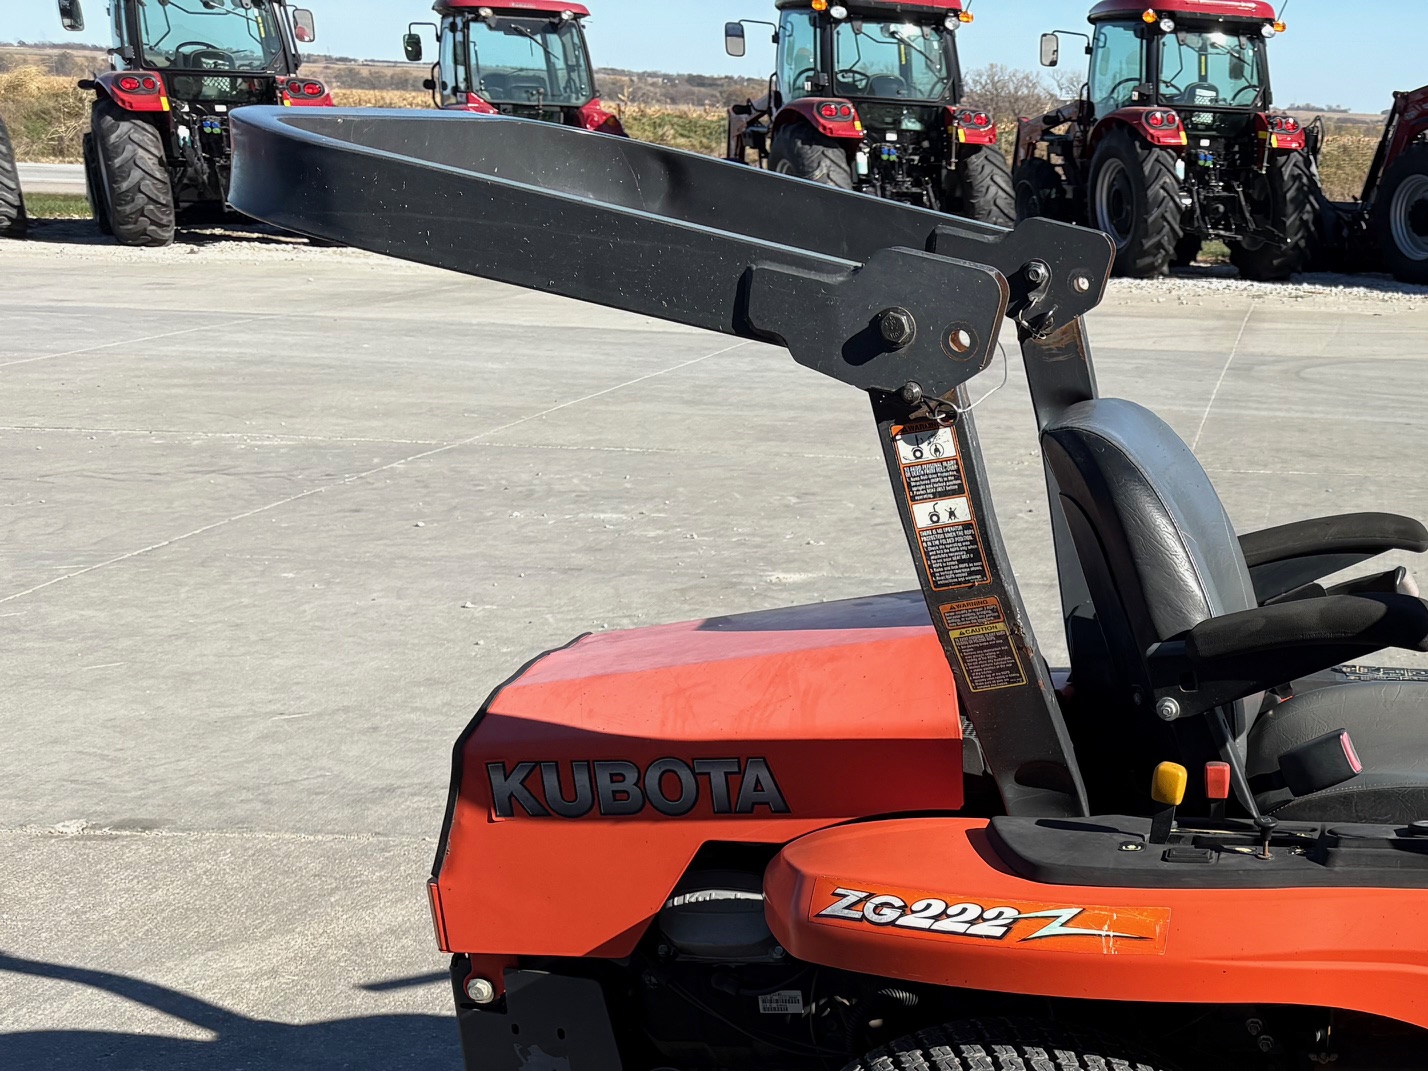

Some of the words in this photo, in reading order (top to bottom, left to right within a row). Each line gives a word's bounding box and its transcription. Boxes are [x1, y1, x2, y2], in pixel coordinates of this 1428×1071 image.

[964, 625, 998, 635] CAUTION
[486, 757, 792, 818] KUBOTA
[814, 886, 1020, 940] ZG222
